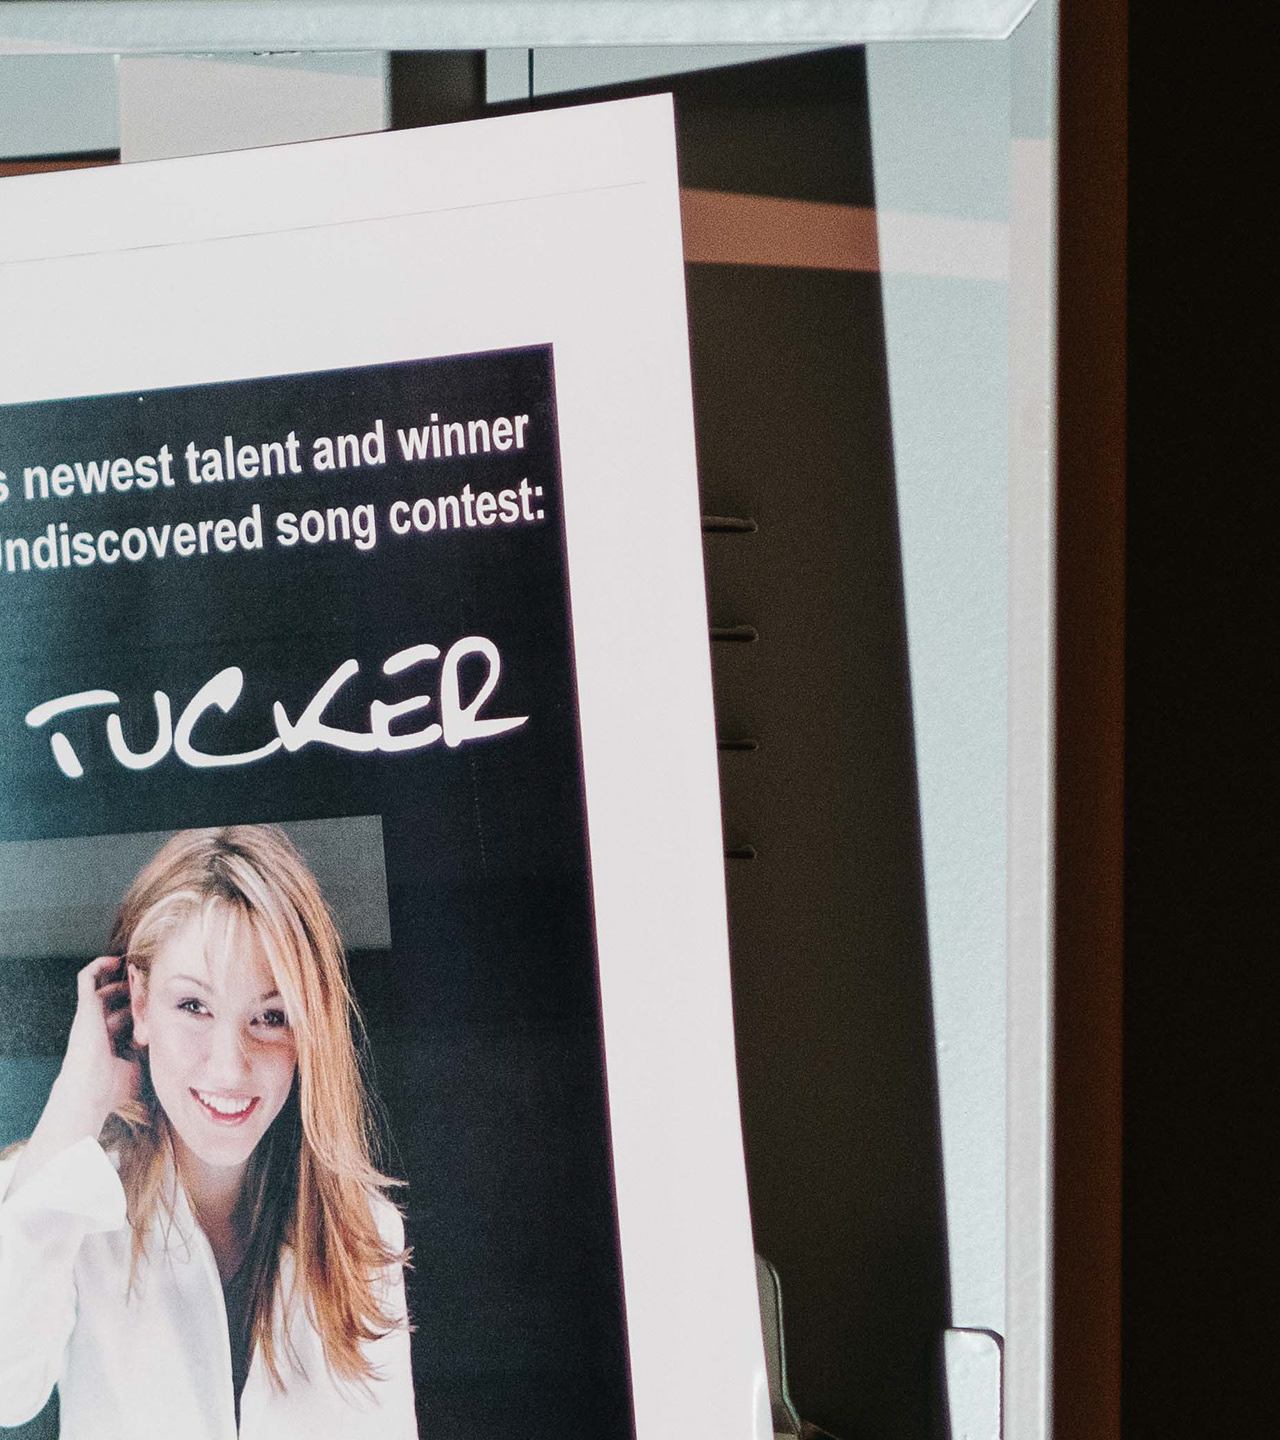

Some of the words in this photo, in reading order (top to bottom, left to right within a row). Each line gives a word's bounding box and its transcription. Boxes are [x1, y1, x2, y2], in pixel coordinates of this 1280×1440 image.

[22, 445, 176, 499] newest
[185, 431, 302, 485] talent
[312, 419, 386, 471] and
[397, 412, 529, 462] winner
[275, 504, 378, 552] song
[388, 479, 546, 536] contest:
[24, 635, 530, 780] TUCKER
